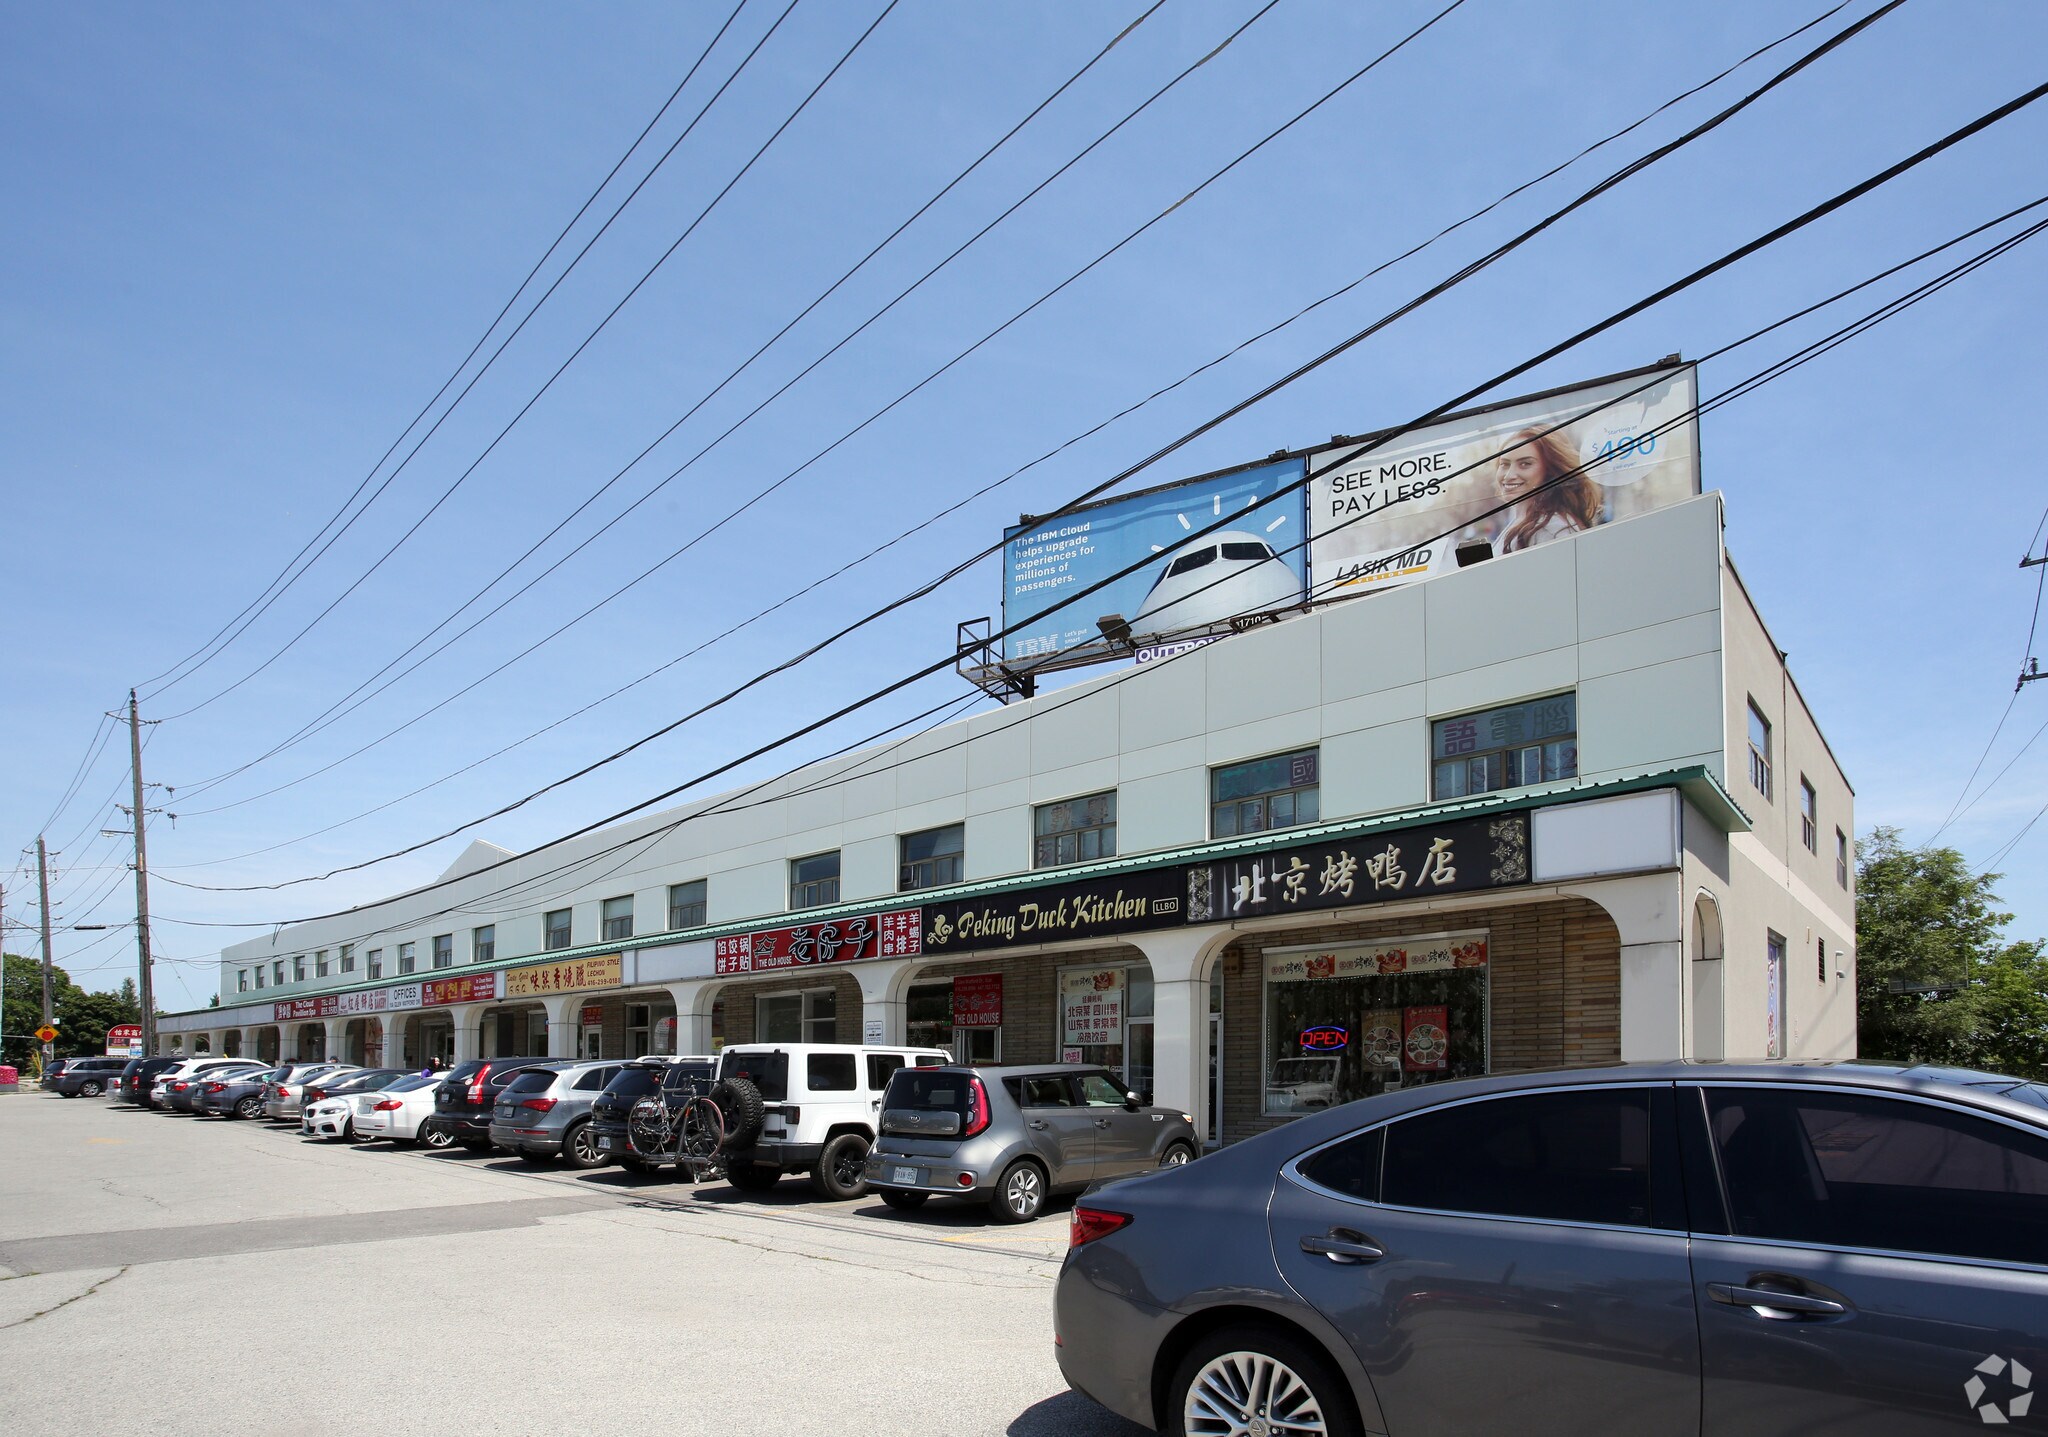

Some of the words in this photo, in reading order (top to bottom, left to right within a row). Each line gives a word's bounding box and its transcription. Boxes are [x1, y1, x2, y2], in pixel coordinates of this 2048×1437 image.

[1332, 469, 1372, 494] SEE
[1380, 452, 1452, 484] MORE.
[1332, 491, 1376, 517] PAY
[1385, 478, 1446, 505] LESS.
[1015, 537, 1034, 548] The
[1037, 530, 1057, 543] IBM
[1060, 522, 1090, 537] Cloud
[1015, 546, 1043, 559] helps
[1046, 535, 1088, 553] upgrade
[1015, 550, 1077, 571] experiences
[1080, 545, 1095, 556] for
[1336, 558, 1390, 581] LASIK
[1396, 549, 1432, 570] MD
[1015, 565, 1056, 582] millions
[1058, 561, 1069, 572] of
[1357, 570, 1404, 583] VISION
[1015, 573, 1076, 596] passengers.
[1064, 630, 1077, 639] Let's
[1078, 628, 1088, 637] put
[1015, 633, 1058, 658] IBM
[1443, 719, 1478, 755] 語
[957, 909, 1016, 940] Peking
[1018, 899, 1067, 932] Duck
[1070, 889, 1146, 929] Kitchen
[1155, 901, 1176, 911] LLBO
[884, 916, 894, 954] 羊肉串
[587, 960, 605, 968] FILIPINO
[607, 958, 620, 966] STYLE
[759, 958, 767, 967] THE
[768, 957, 776, 967] OLD
[777, 956, 792, 965] HOUSE
[587, 970, 605, 978] LECHON
[394, 987, 417, 1000] OFFICES
[435, 981, 471, 1001] 인천관
[303, 1000, 315, 1008] Cloud
[1068, 1005, 1091, 1017] 北京菜
[1093, 1003, 1118, 1016] 四川菜
[293, 1009, 308, 1017] Pavilion
[955, 1014, 966, 1025] THE
[967, 1013, 978, 1025] OLD
[979, 1012, 999, 1024] HOUSE
[1093, 1017, 1118, 1029] 家常菜
[1300, 1031, 1348, 1045] OPEN
